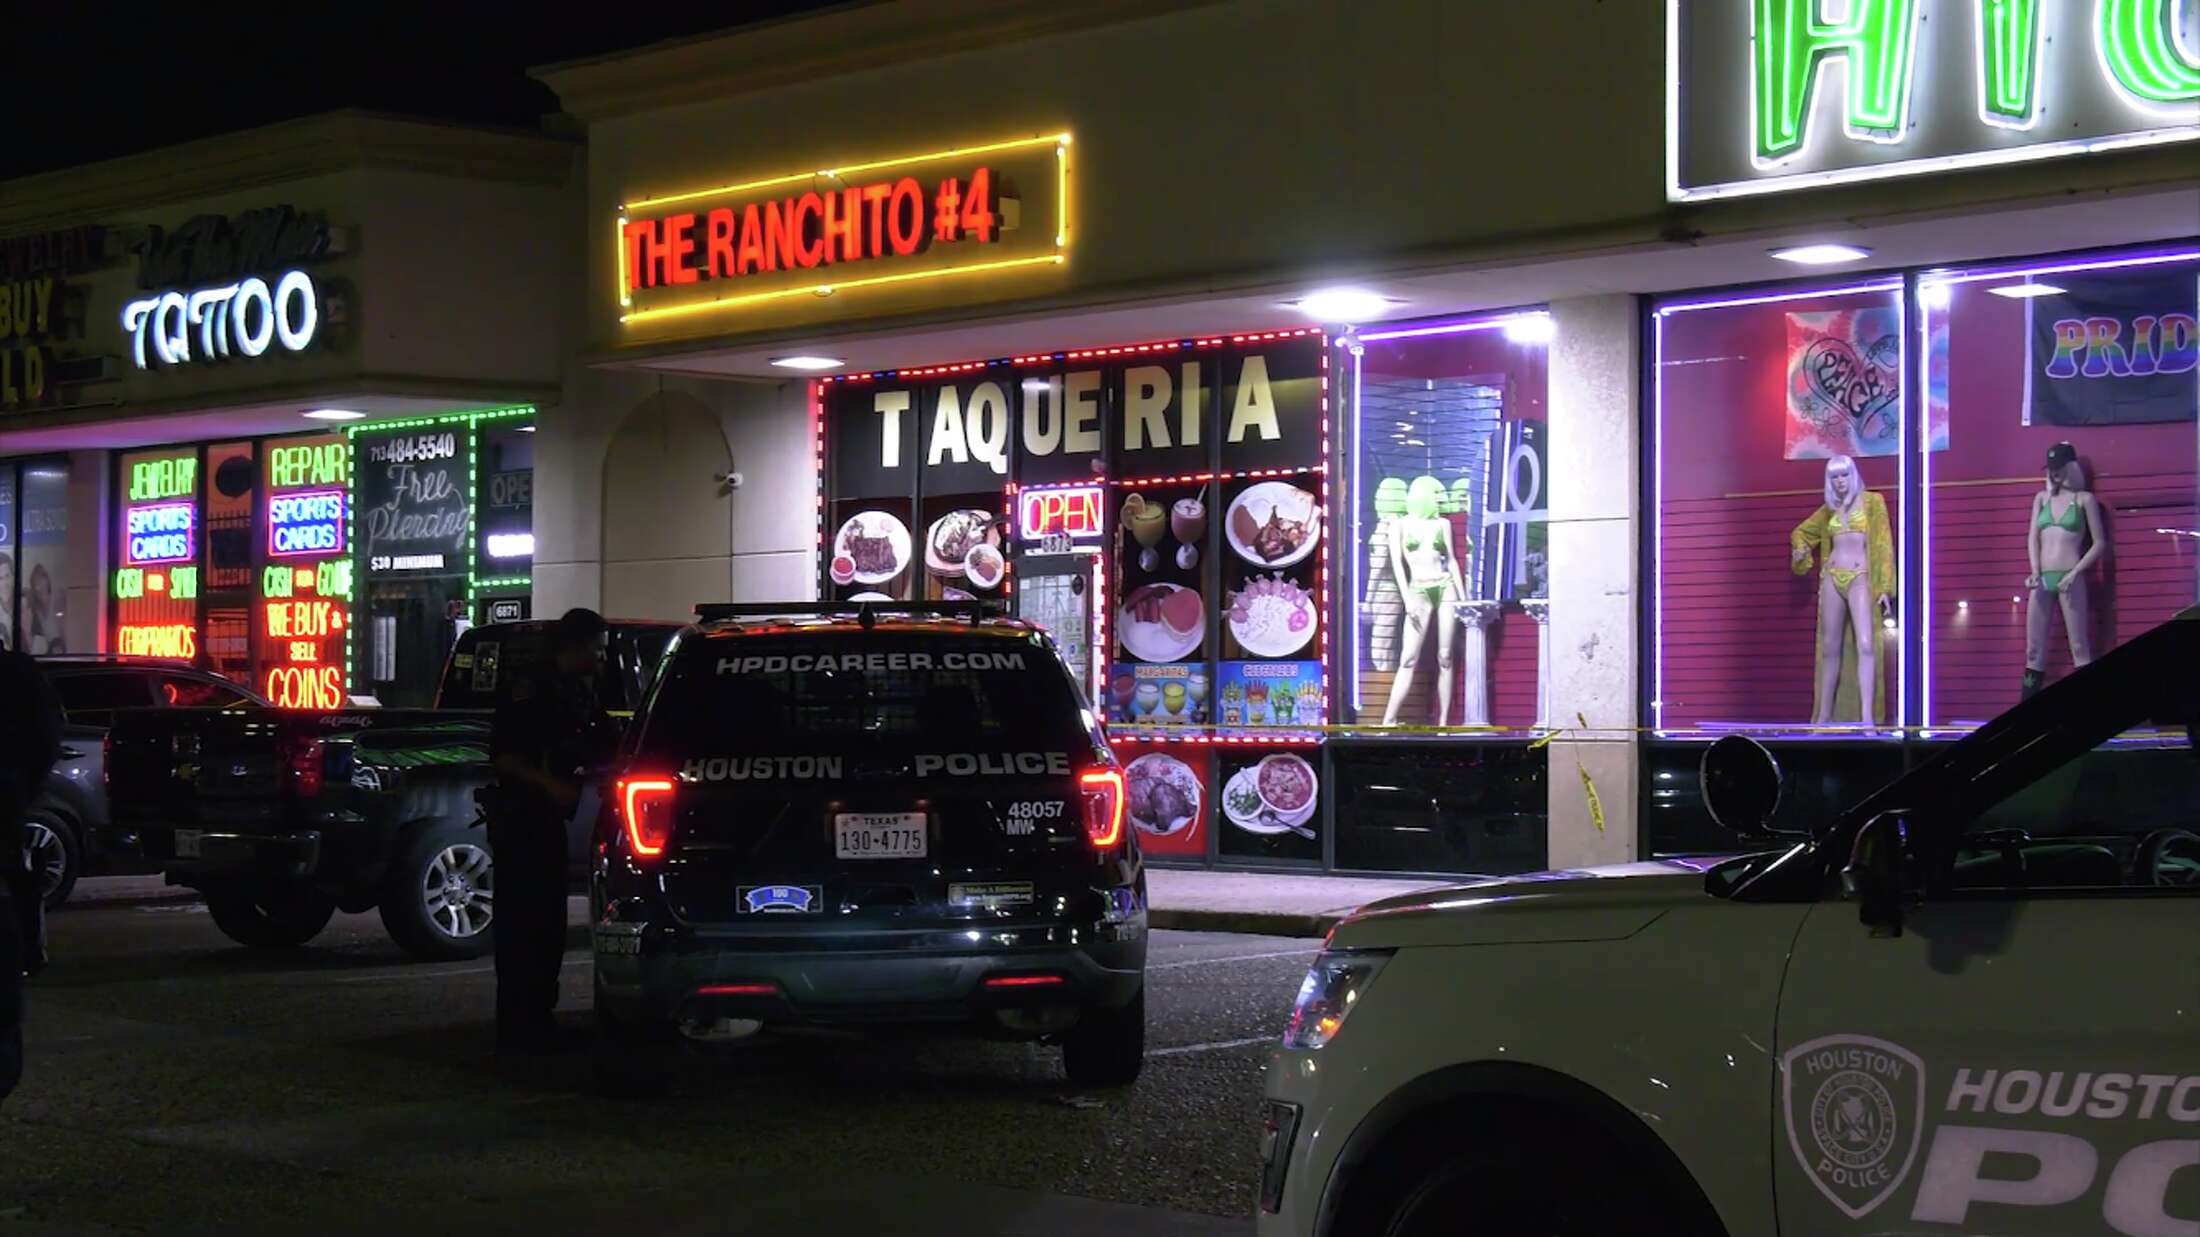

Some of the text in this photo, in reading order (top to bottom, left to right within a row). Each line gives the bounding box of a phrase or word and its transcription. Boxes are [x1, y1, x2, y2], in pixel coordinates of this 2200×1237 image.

[623, 167, 993, 288] THE RANCHITO #4
[386, 433, 455, 463] 484-5540
[271, 444, 346, 487] REPAIR
[387, 464, 455, 510] Free
[490, 473, 530, 504] OPE
[128, 507, 191, 533] SPORTS
[271, 496, 342, 524] SPORTS
[1025, 492, 1101, 535] OPEN
[131, 535, 187, 560] CARDS
[274, 524, 336, 551] CARDS
[267, 602, 293, 637] WE
[294, 601, 331, 636] BUY
[716, 653, 1027, 676] HPDCAREER.COM
[267, 667, 341, 710] COINS
[681, 751, 1072, 783] HOUSTON POLICE
[863, 817, 899, 825] TEXAS
[1008, 801, 1065, 819] 48057
[1805, 1049, 1902, 1081] HOUSTON
[1815, 1157, 1892, 1189] POLICE
